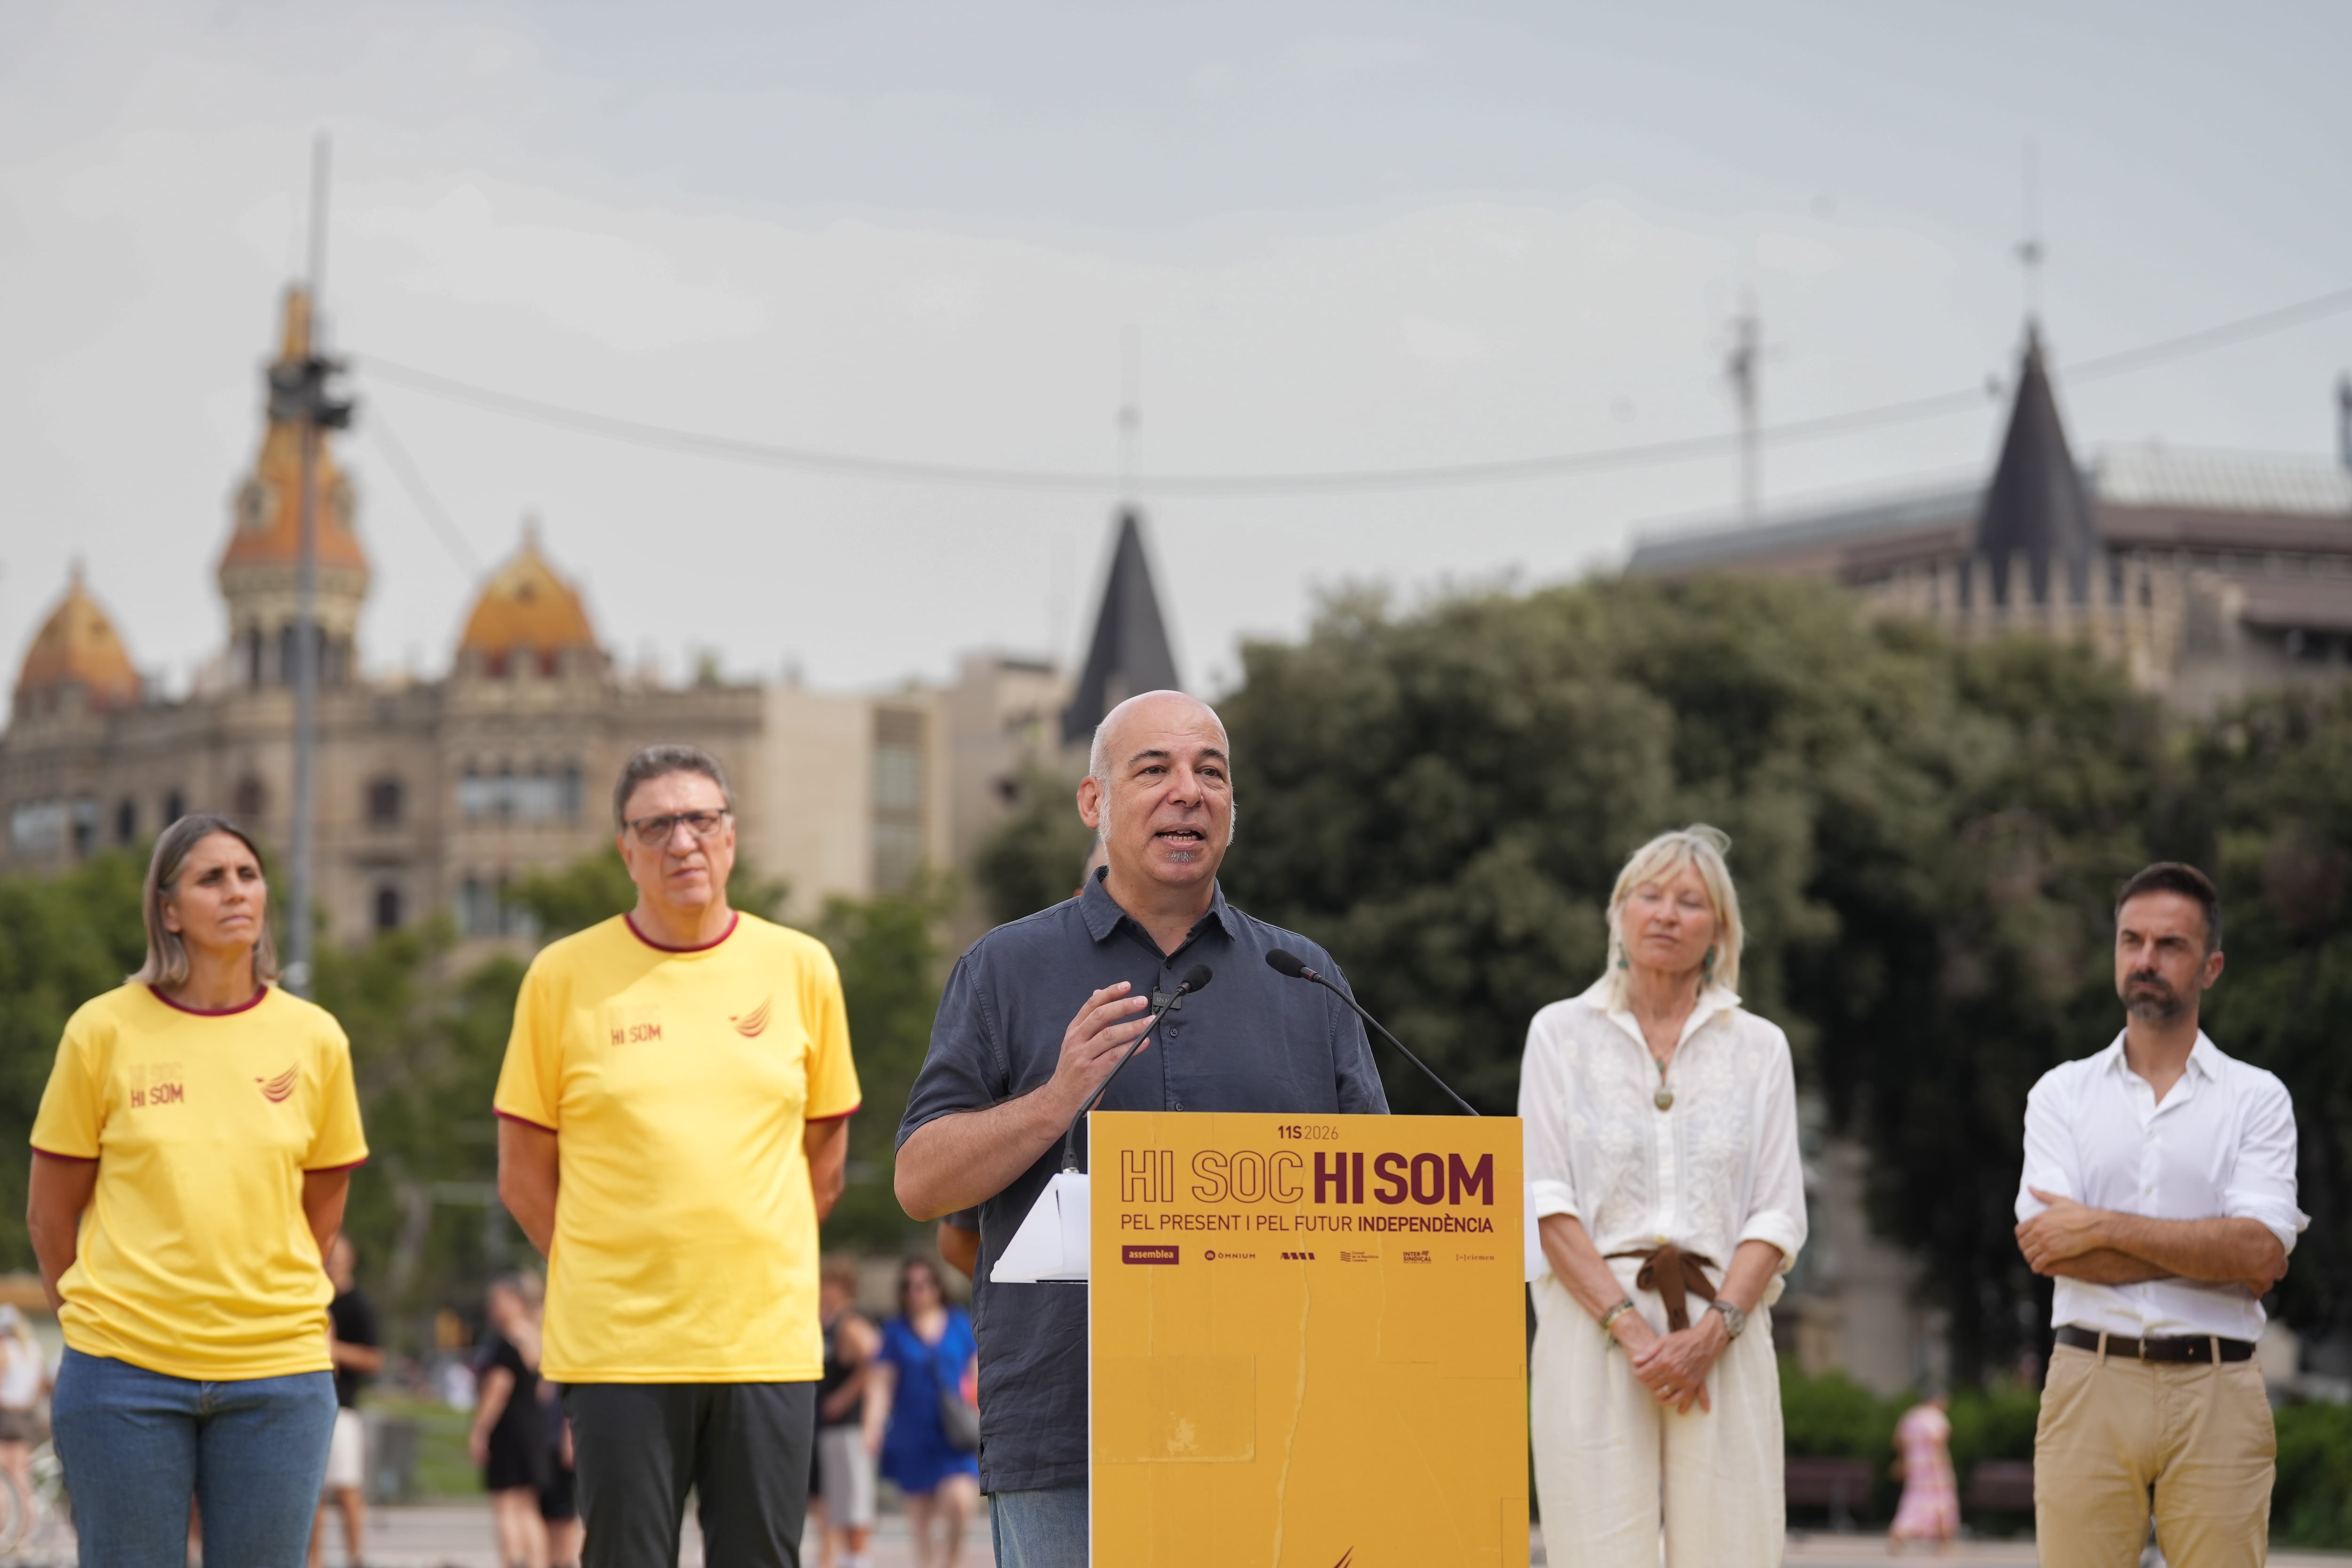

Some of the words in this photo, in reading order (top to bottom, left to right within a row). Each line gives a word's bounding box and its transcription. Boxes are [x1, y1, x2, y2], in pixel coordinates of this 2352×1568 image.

[611, 1028, 624, 1046] HI
[629, 1023, 661, 1043] SOM
[131, 1090, 145, 1108] HI
[150, 1083, 184, 1105] SOM
[1304, 1125, 1339, 1140] 2026
[1121, 1150, 1174, 1202] HI
[1192, 1150, 1303, 1204] SOC
[1314, 1152, 1364, 1204] HI
[1373, 1152, 1494, 1206] SOM
[1121, 1214, 1154, 1230] PEL
[1160, 1214, 1241, 1231] PRESENT
[1247, 1215, 1250, 1231] I
[1256, 1215, 1289, 1231] PEL
[1295, 1216, 1352, 1232] FUTUR
[1358, 1213, 1494, 1233] INDEPENDÈNCIA
[1128, 1250, 1174, 1258] assemblea
